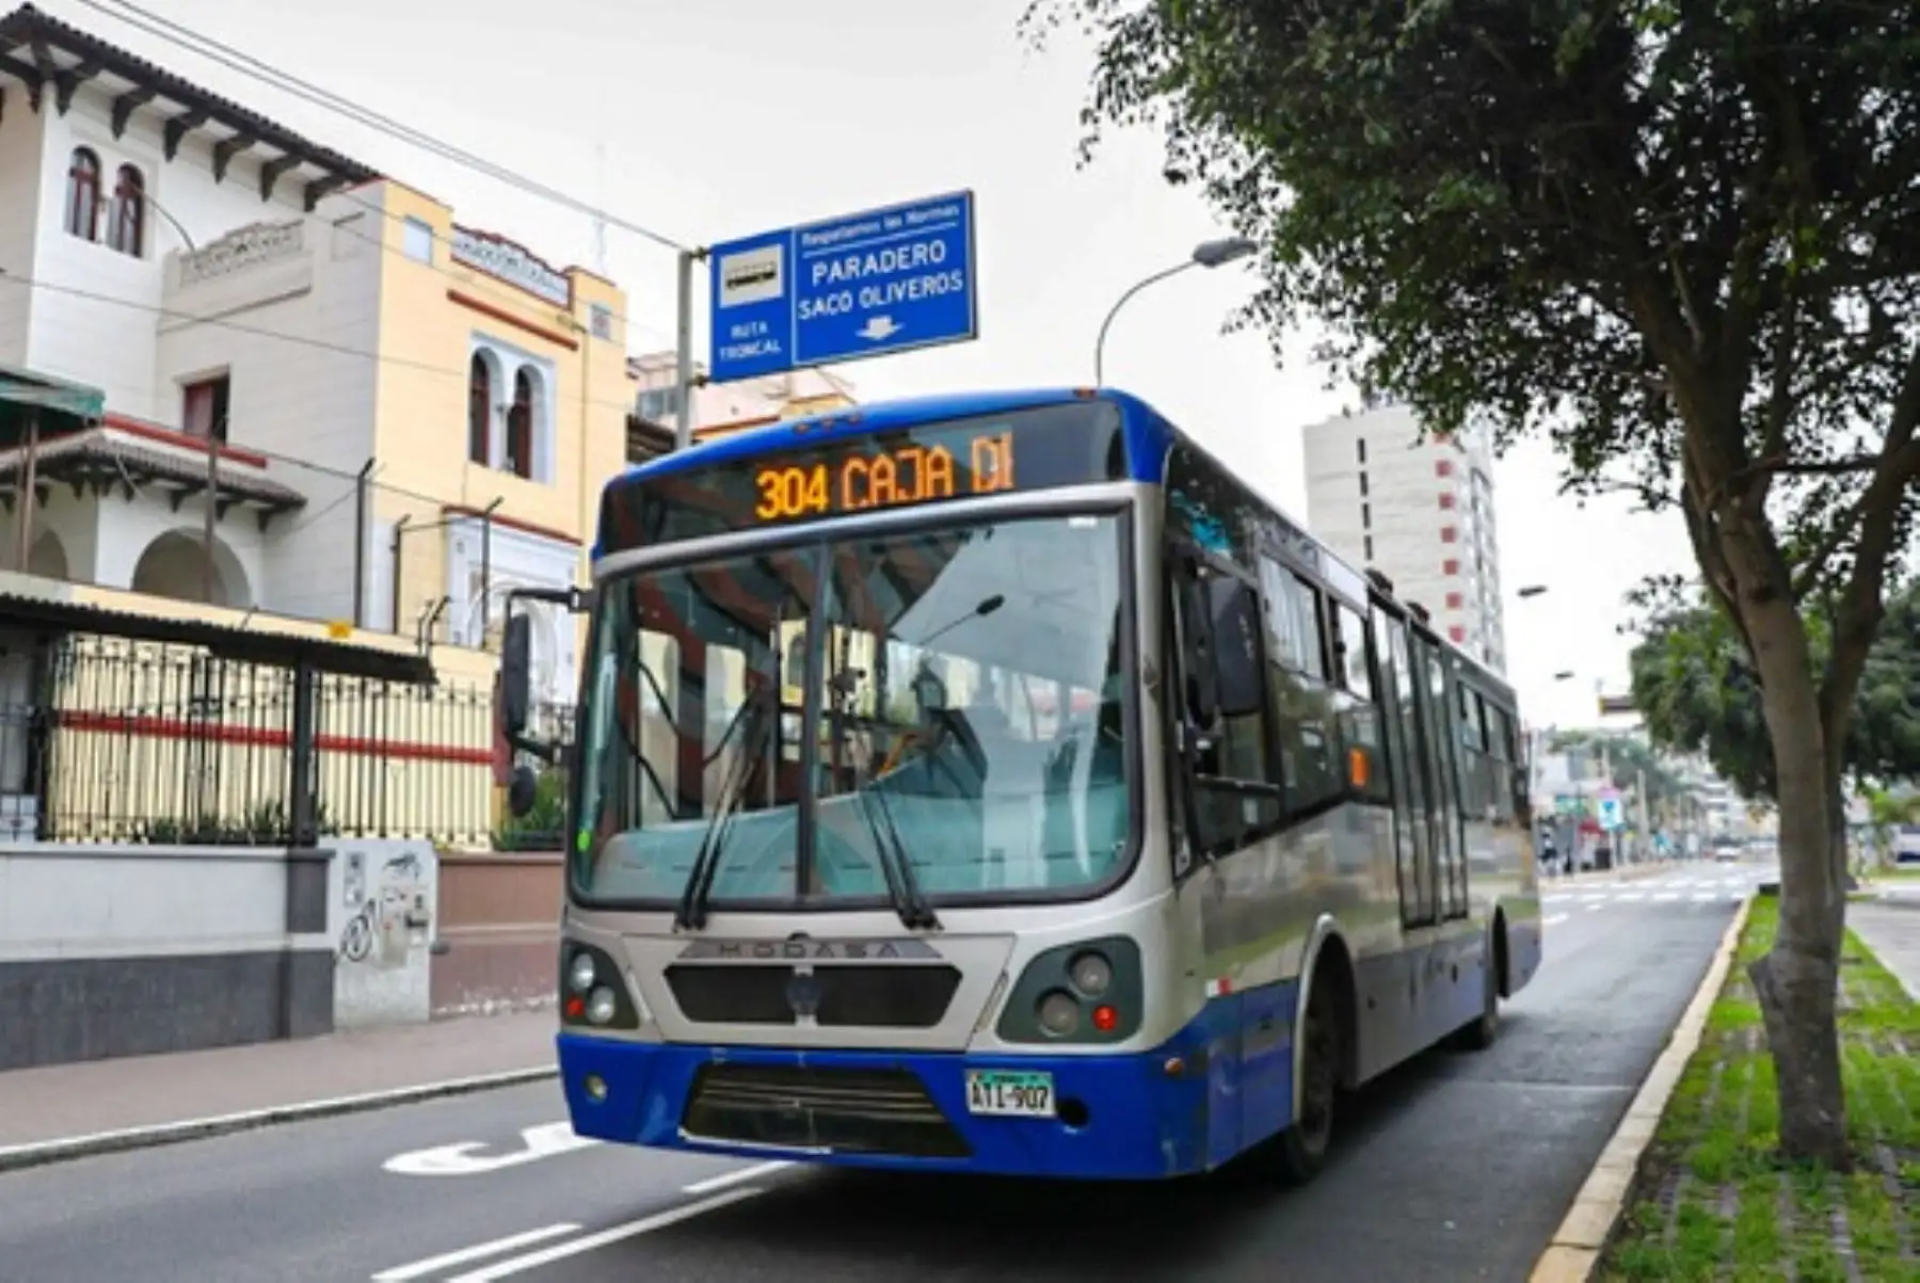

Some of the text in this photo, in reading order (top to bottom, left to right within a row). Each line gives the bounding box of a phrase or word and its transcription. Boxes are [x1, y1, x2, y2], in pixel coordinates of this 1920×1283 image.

[812, 239, 946, 286] PARADERO
[798, 271, 964, 320] SACO OLIVEROS
[719, 339, 782, 361] TRONCAL
[730, 321, 769, 339] RUTA
[755, 464, 829, 519] 304
[841, 448, 954, 512] CAJA
